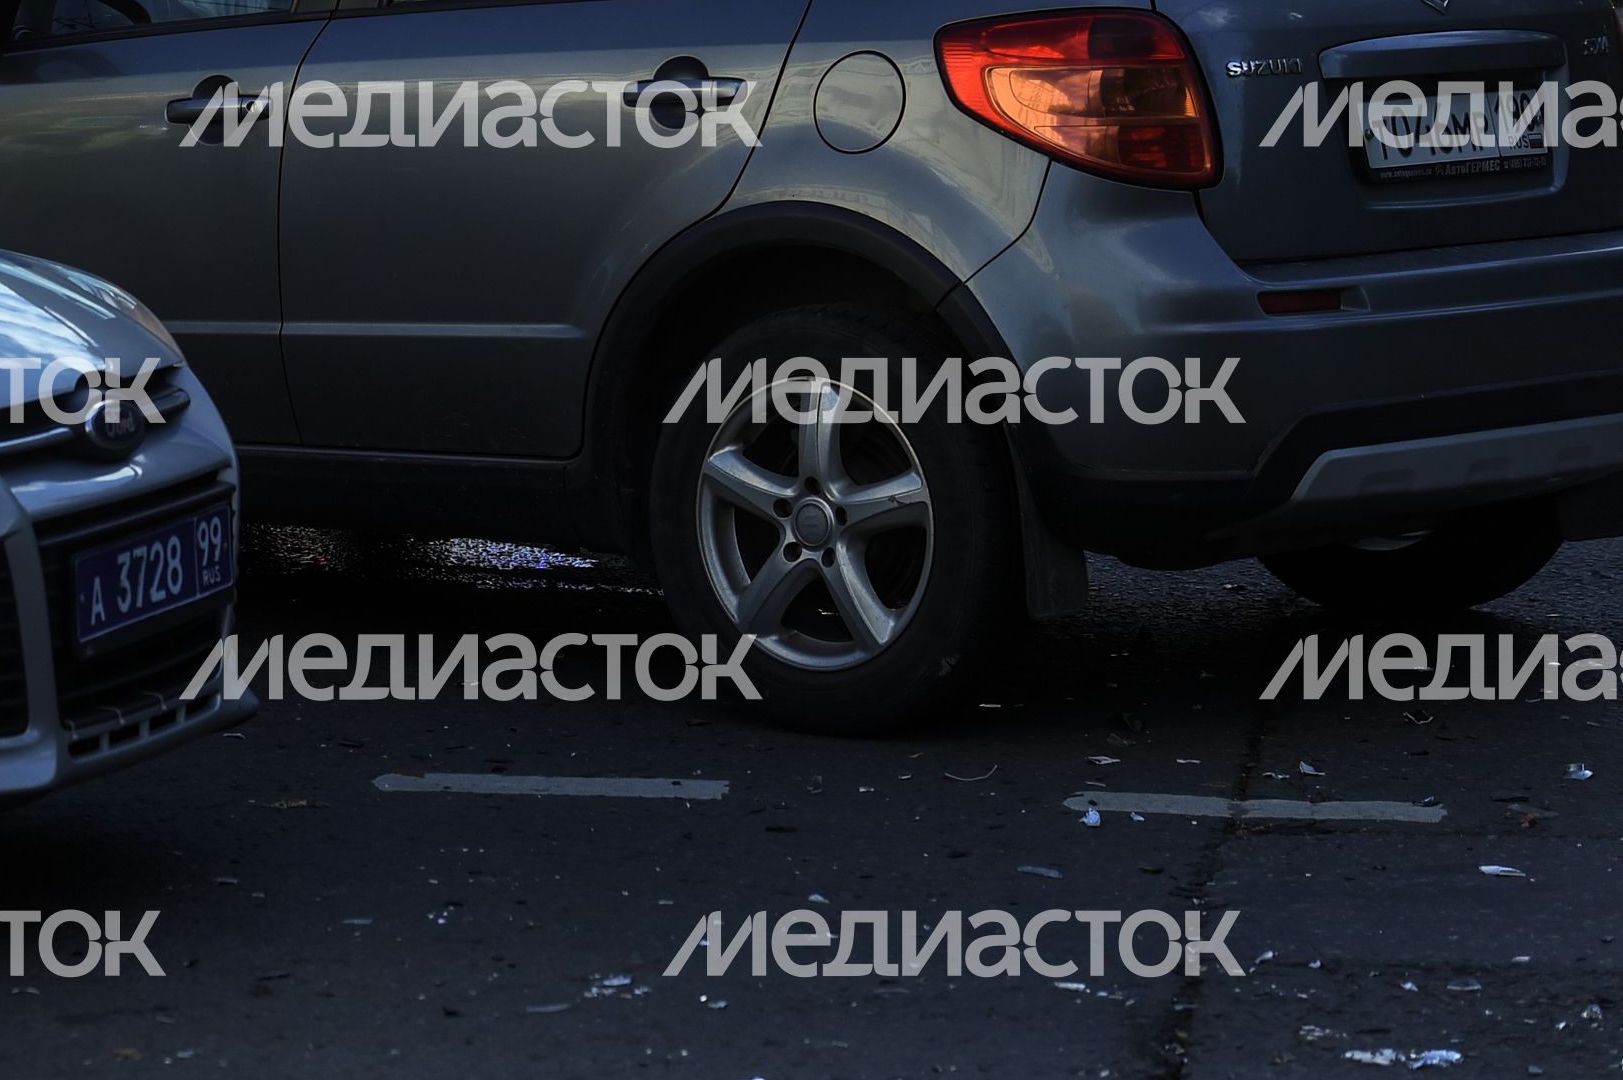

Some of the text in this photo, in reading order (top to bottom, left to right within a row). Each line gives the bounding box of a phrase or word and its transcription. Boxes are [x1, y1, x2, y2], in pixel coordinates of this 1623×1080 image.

[1227, 57, 1304, 77] SUZUKI
[117, 535, 184, 614] 3728
[197, 516, 222, 567] 99
[202, 566, 221, 585] RUS
